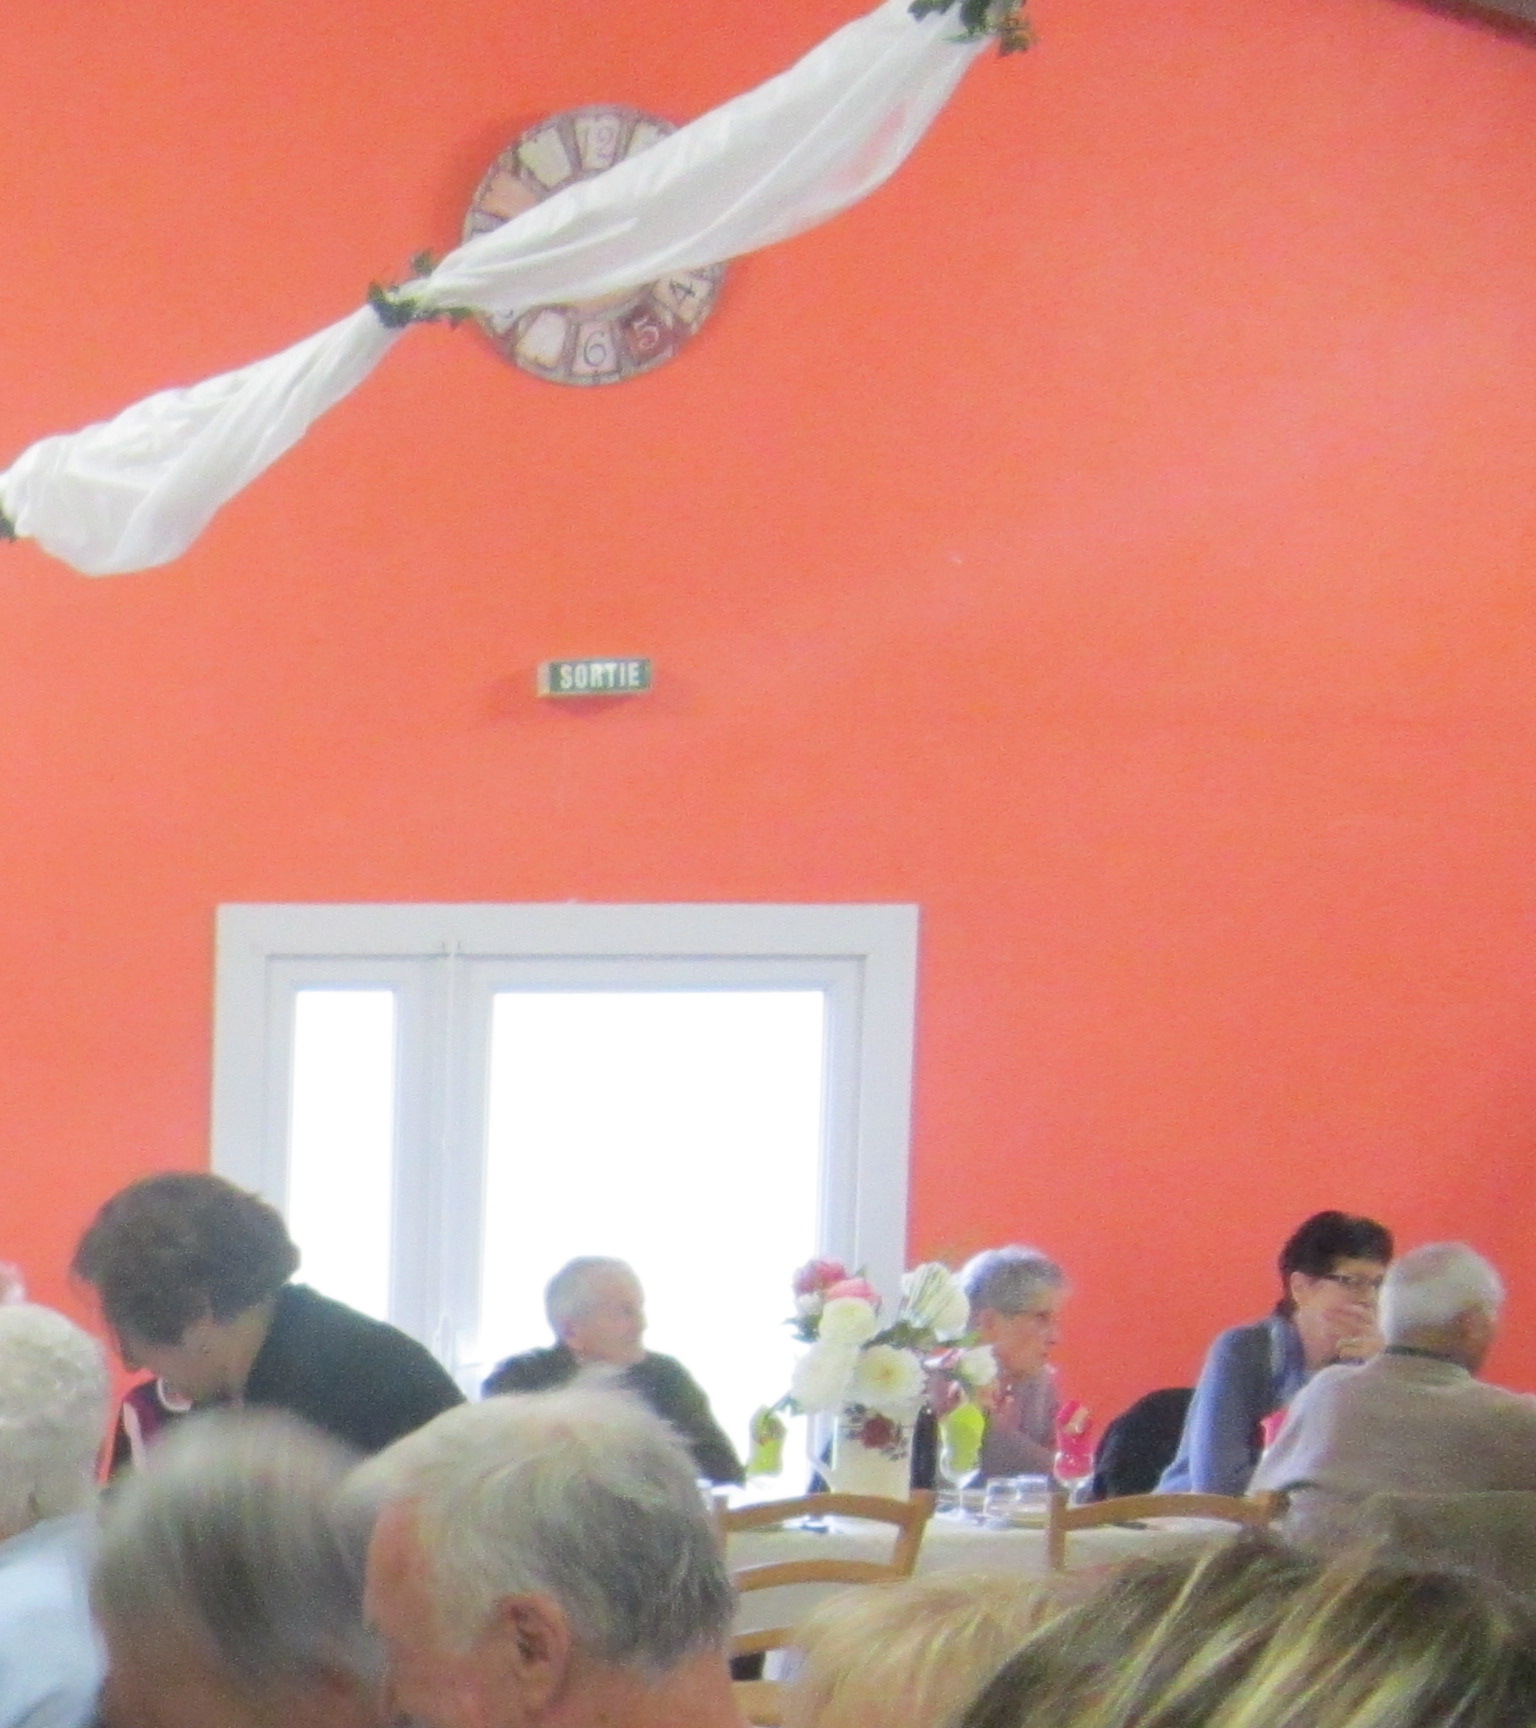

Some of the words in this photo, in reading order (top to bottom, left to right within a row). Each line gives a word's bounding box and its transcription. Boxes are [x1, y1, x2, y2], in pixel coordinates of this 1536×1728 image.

[582, 329, 608, 368] 6
[631, 314, 661, 351] 5
[559, 661, 641, 689] SORTIE
